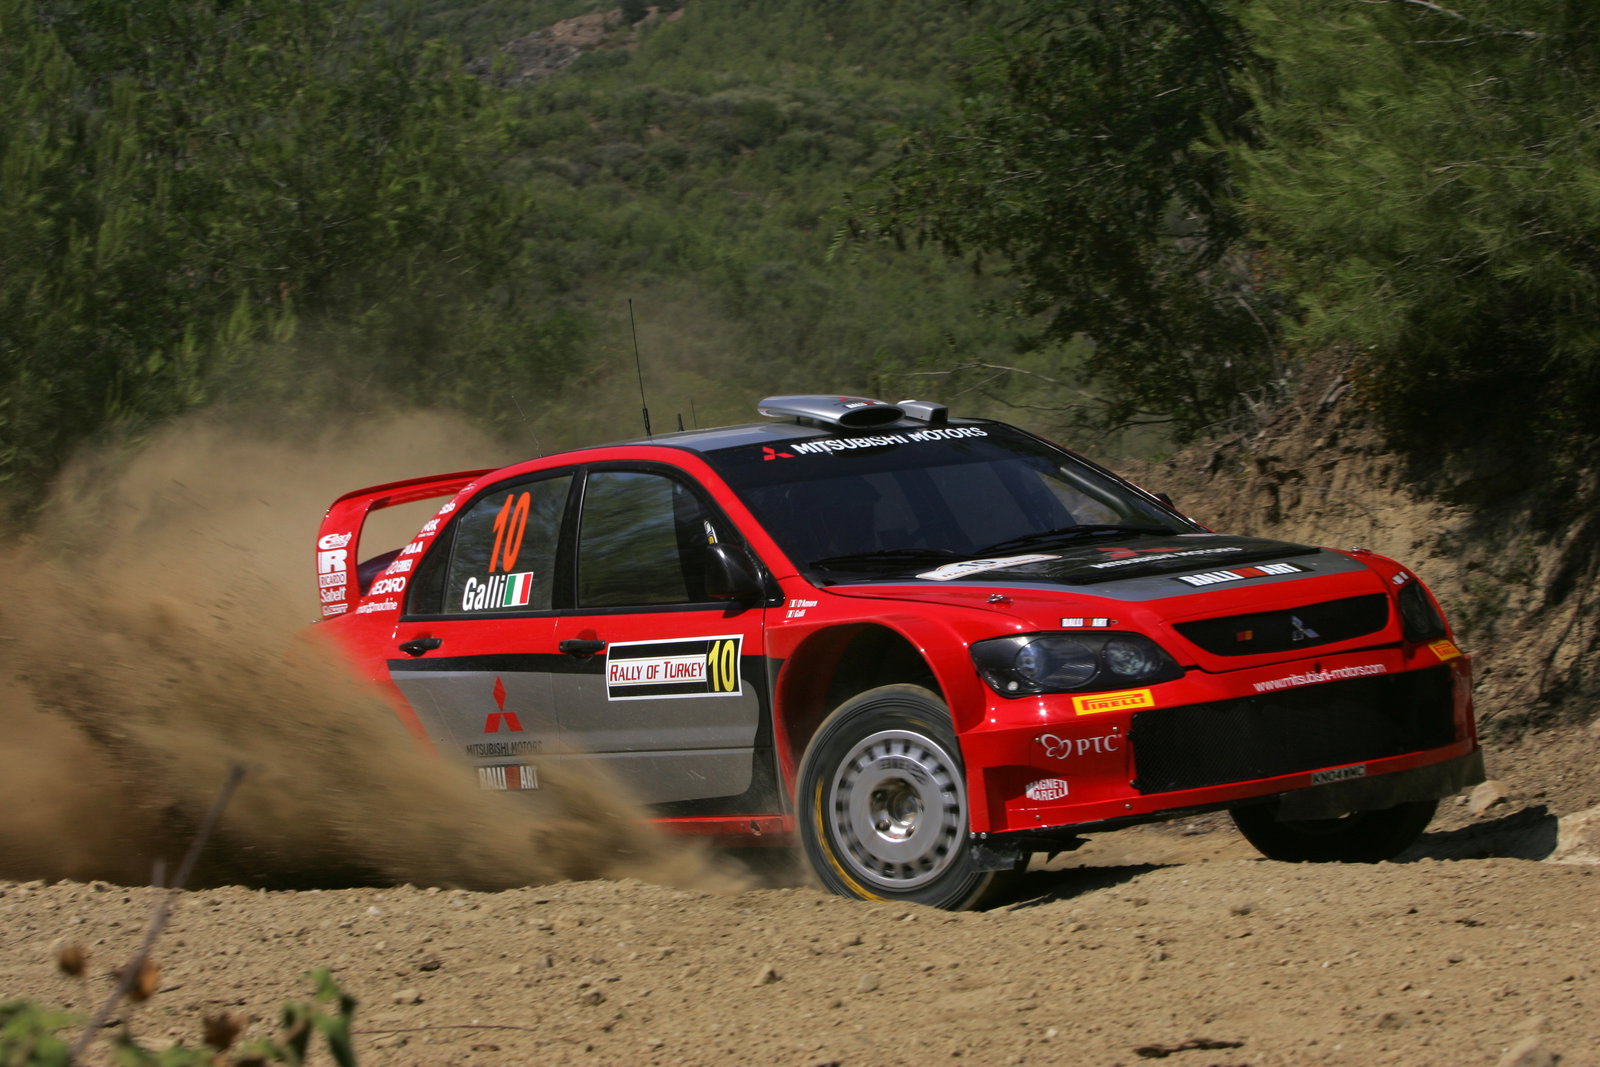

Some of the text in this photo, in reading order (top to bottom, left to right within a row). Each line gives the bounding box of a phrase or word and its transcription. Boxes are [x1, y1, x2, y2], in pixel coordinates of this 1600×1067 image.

[790, 427, 988, 455] MITSUBISHI MOTORS
[489, 491, 531, 572] 10
[320, 573, 345, 586] RICARDO
[462, 576, 505, 611] Galli
[610, 661, 705, 682] RALLY OF TURKEY
[708, 640, 734, 692] 10
[1081, 692, 1146, 711] PIRELLI
[466, 740, 543, 757] MITSUBISHI MOTORS
[1076, 734, 1119, 756] PTC
